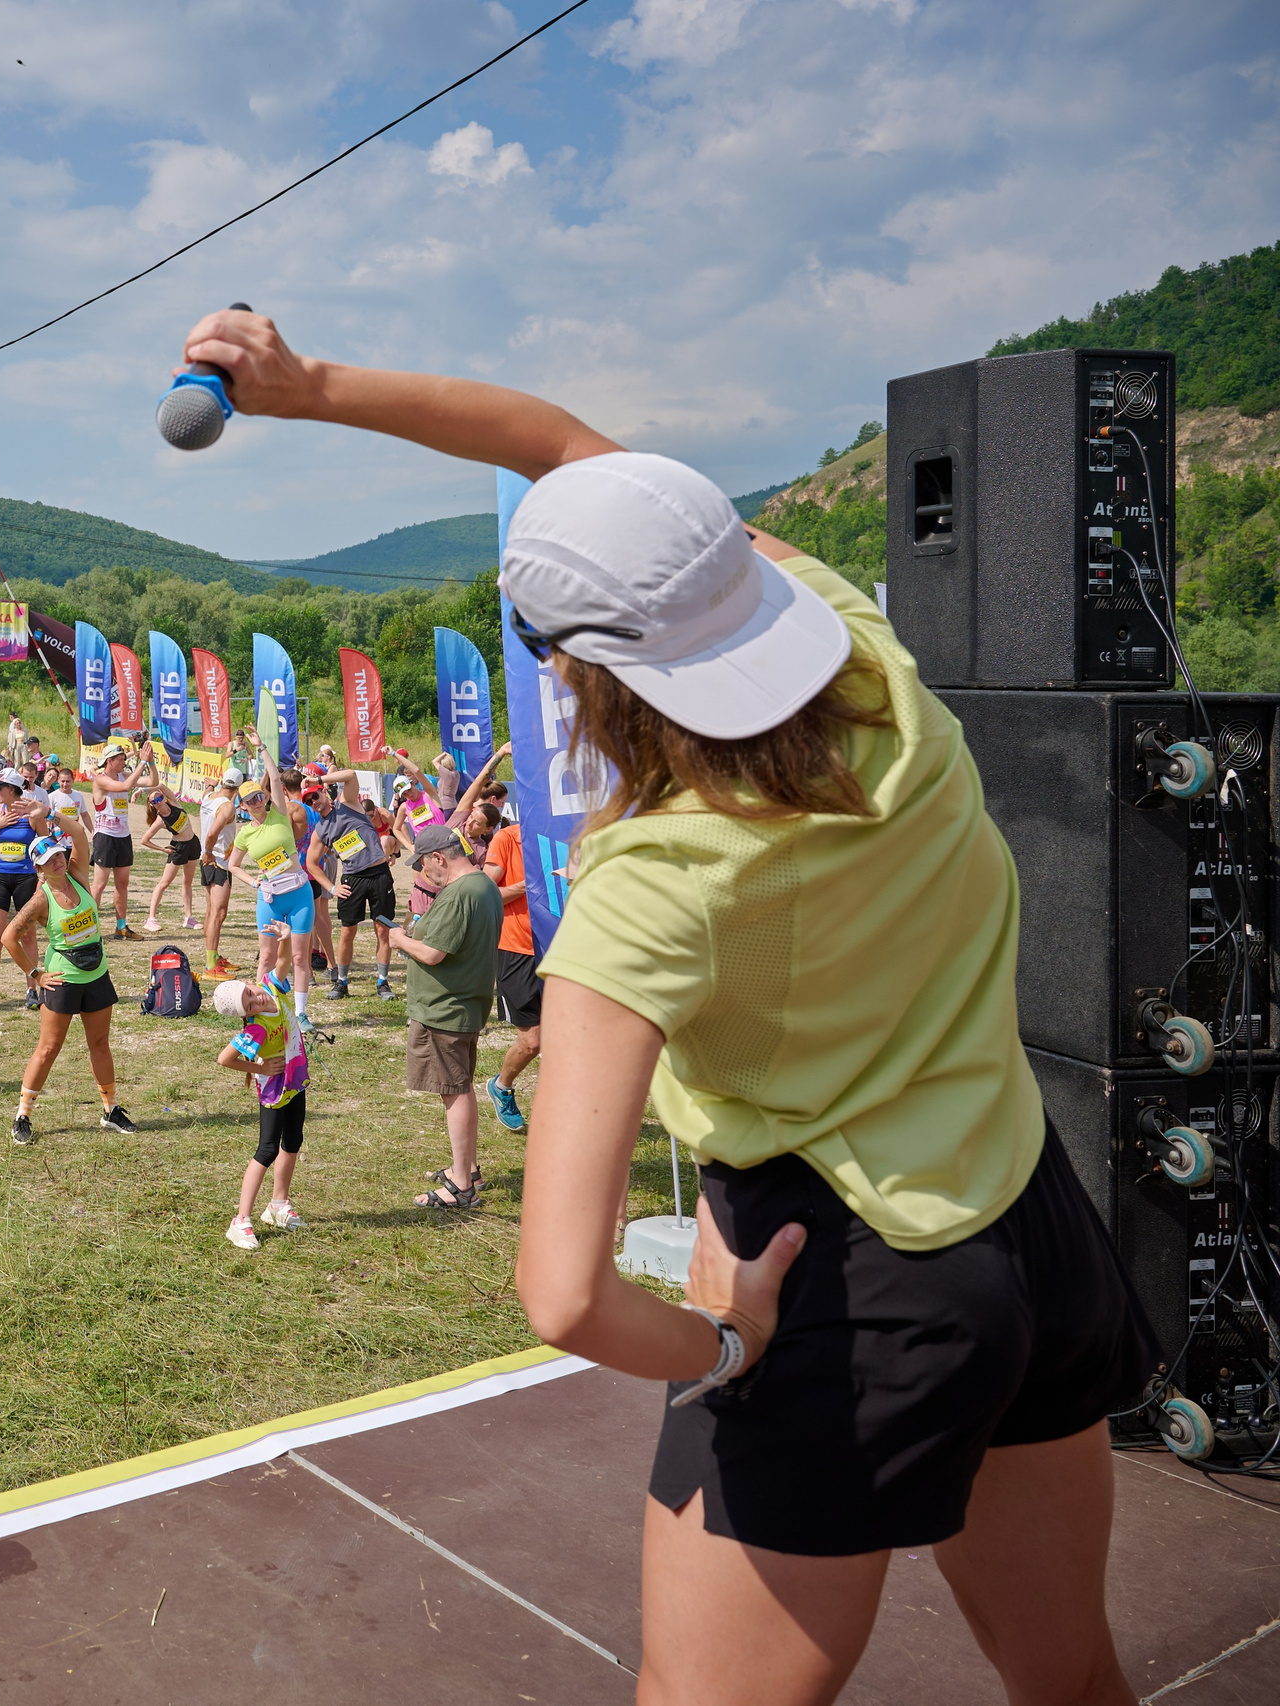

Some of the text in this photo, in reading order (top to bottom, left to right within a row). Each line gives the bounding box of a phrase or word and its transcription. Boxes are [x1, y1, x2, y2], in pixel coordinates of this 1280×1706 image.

[43, 634, 76, 659] VOLGA
[85, 658, 103, 701] ВТБ
[160, 671, 180, 720] ВТБ
[450, 680, 480, 742] ВТБ
[190, 760, 223, 779] ВТБ ЛУКА
[68, 917, 92, 931] 5061
[174, 974, 182, 1011] RUSSIA
